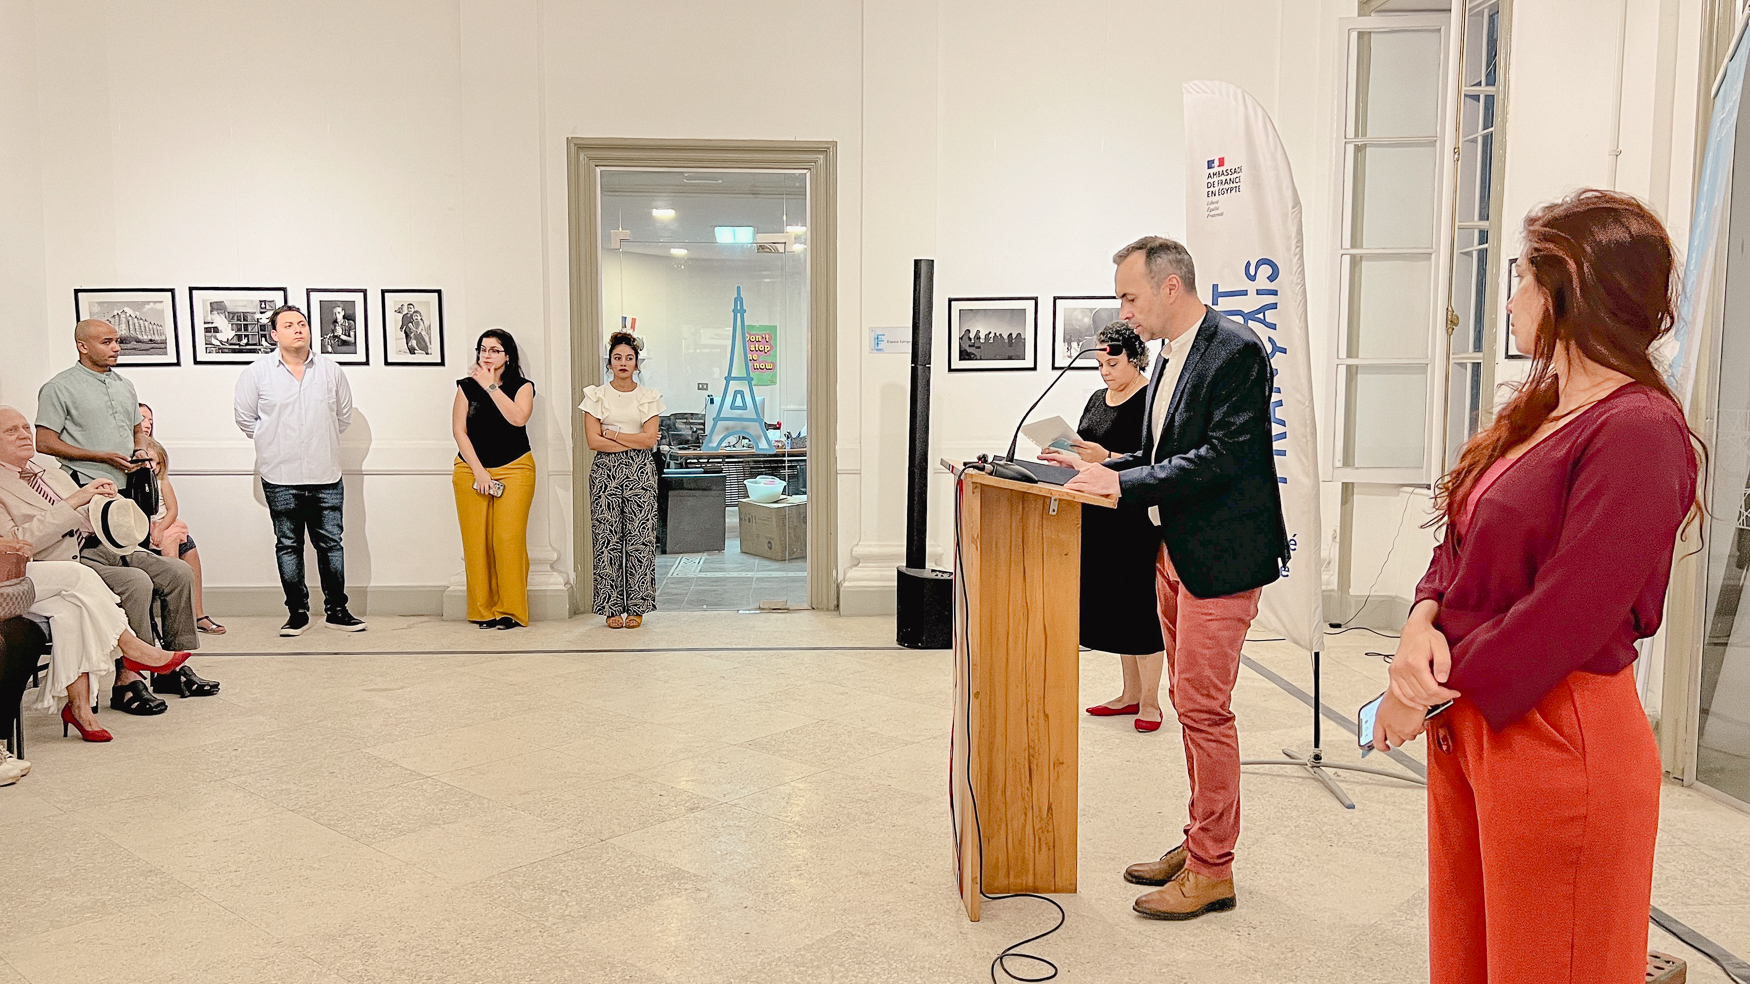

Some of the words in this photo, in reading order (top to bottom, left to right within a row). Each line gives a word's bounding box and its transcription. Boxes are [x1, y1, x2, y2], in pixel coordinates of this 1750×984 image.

[1207, 181, 1216, 189] DE
[1217, 176, 1241, 186] FRANCE
[1207, 190, 1216, 198] EN
[1218, 185, 1241, 196] ÉGYPTE
[750, 344, 770, 354] stop
[754, 362, 773, 370] now
